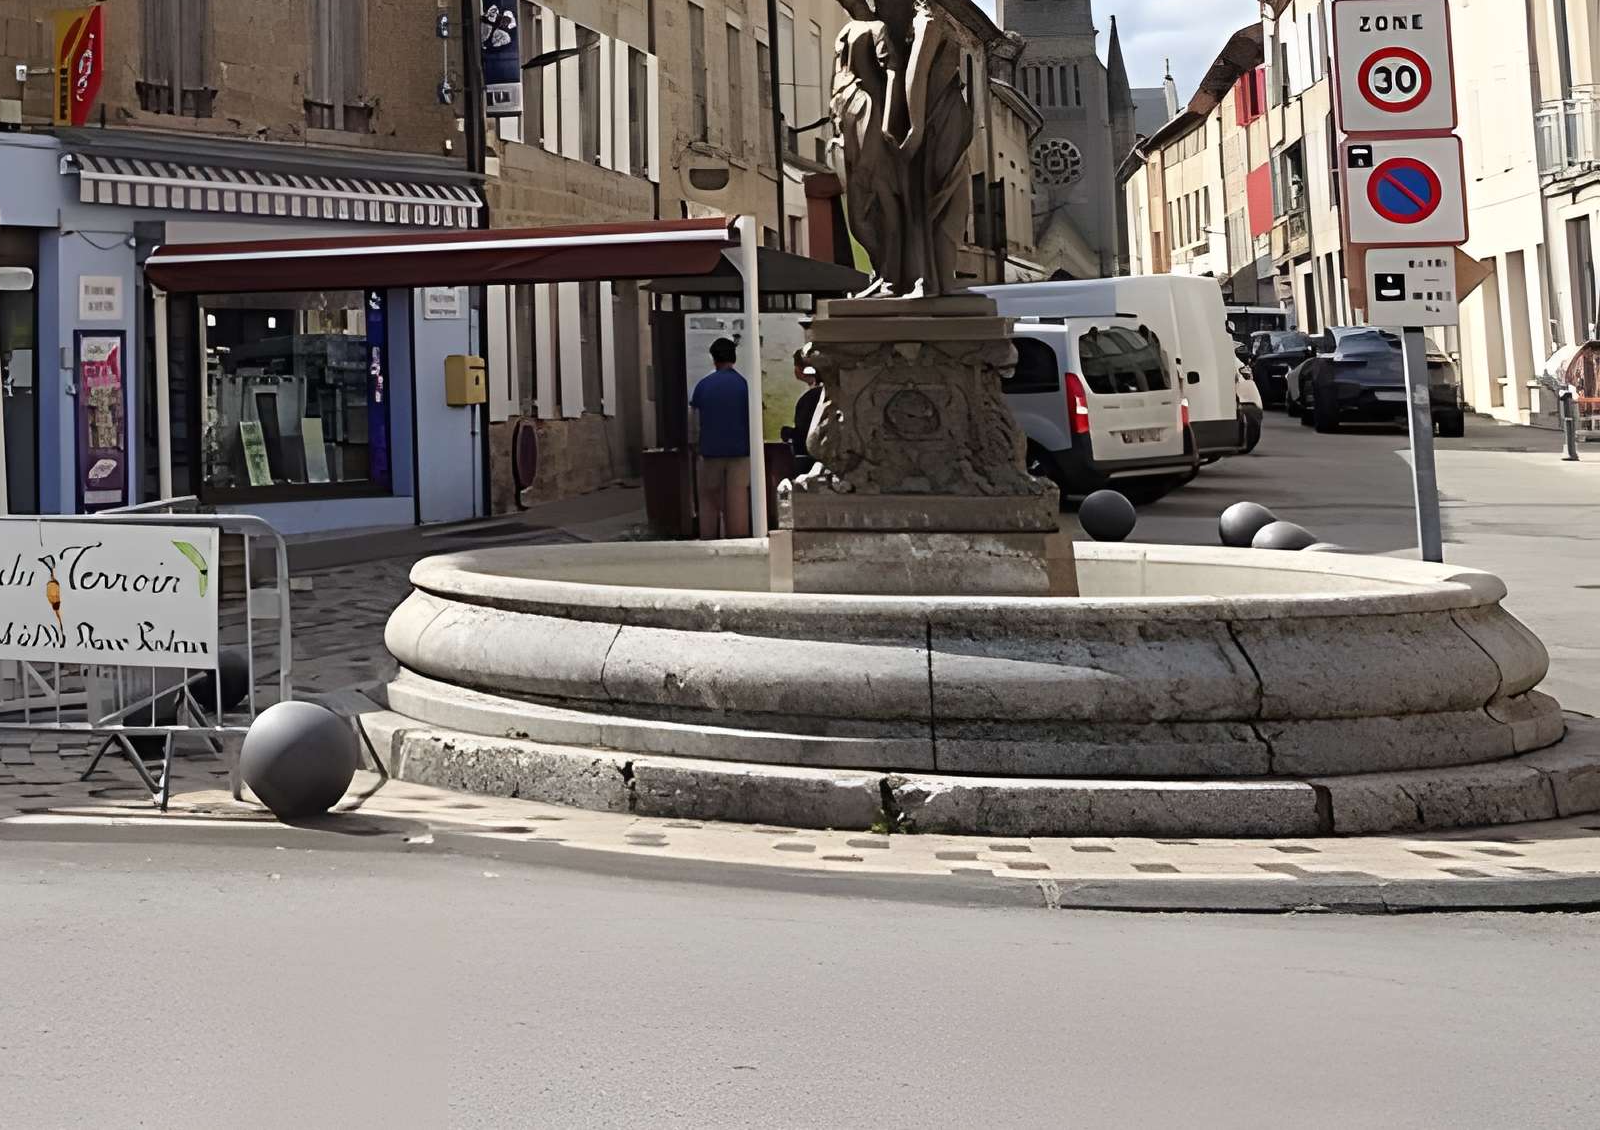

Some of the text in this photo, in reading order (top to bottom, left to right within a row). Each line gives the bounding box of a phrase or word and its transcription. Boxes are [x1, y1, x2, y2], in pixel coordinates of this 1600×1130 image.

[1359, 13, 1424, 32] ZONE
[1373, 64, 1418, 95] 30
[59, 541, 181, 594] Terroir
